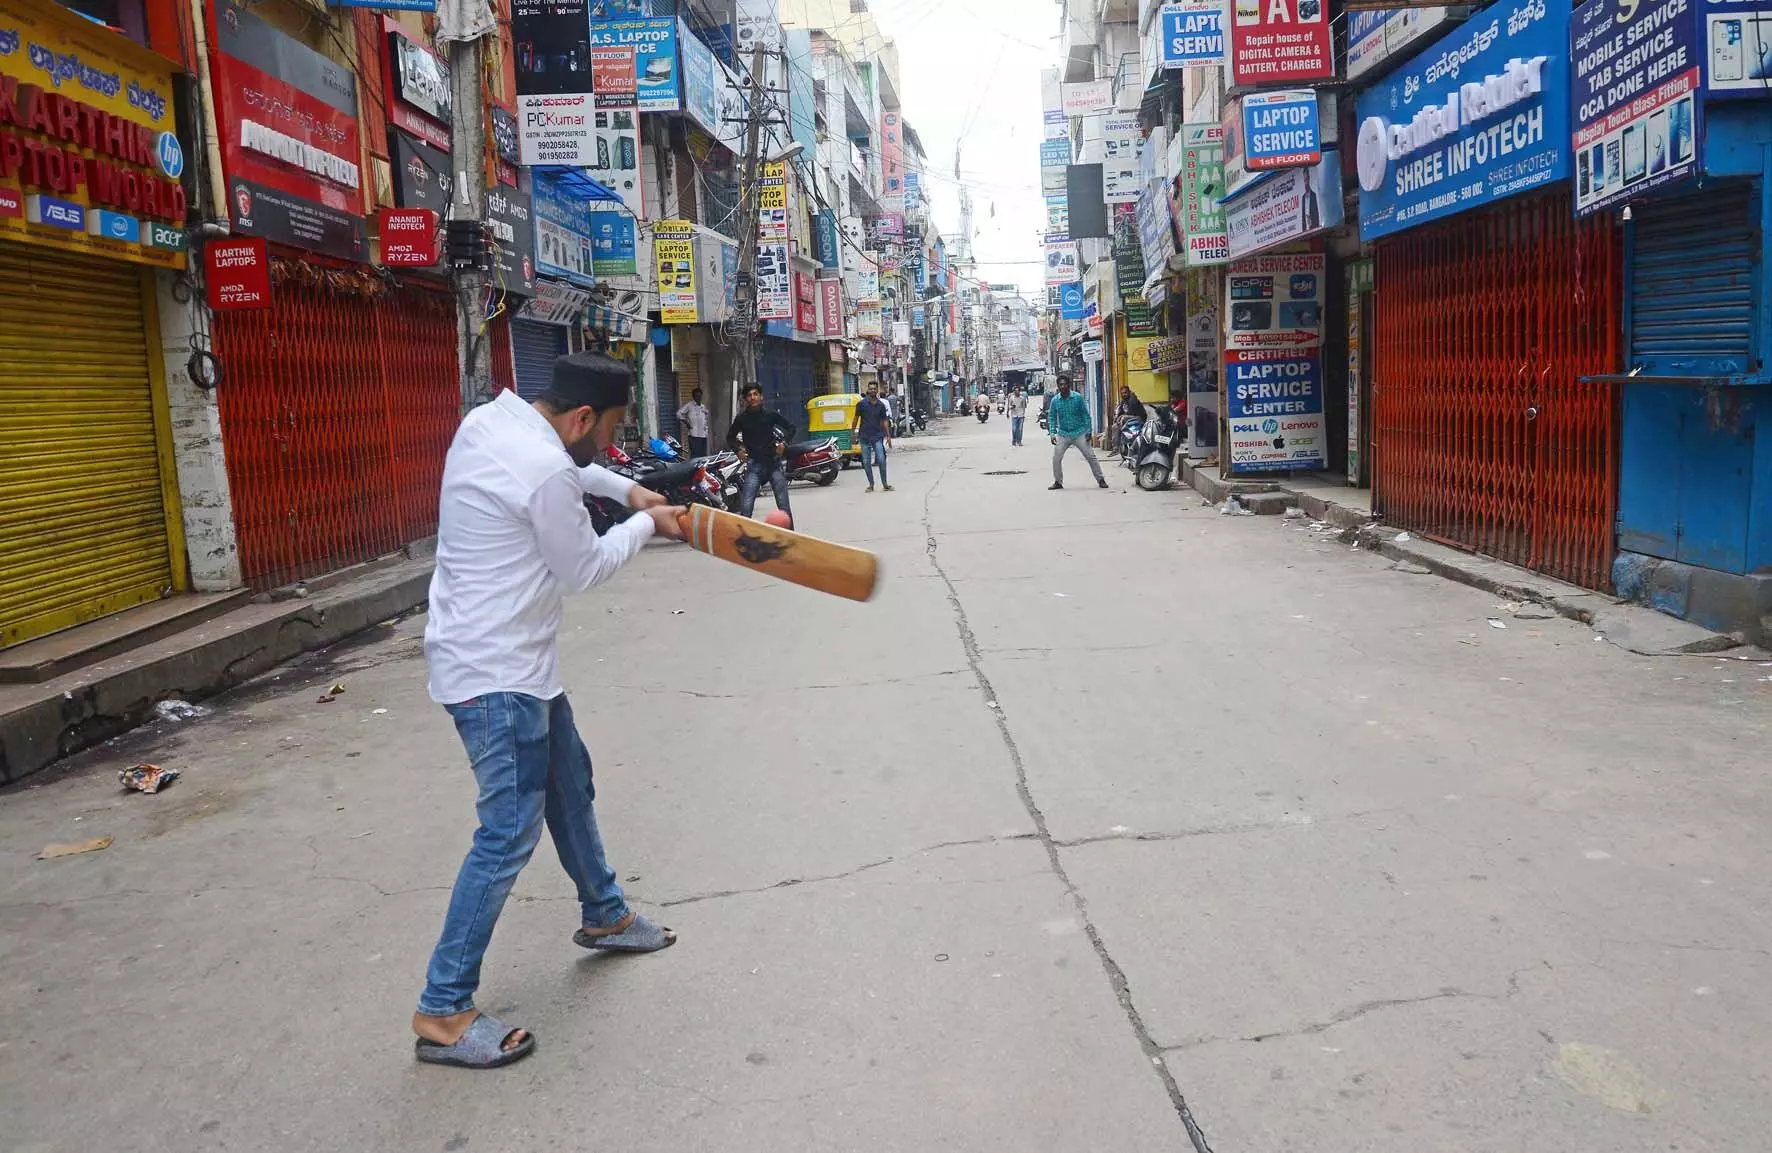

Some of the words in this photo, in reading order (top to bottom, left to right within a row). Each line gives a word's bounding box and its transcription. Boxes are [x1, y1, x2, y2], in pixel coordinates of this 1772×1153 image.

[618, 31, 669, 42] LAPTOP
[1246, 34, 1274, 47] Repair
[1276, 33, 1302, 43] house
[1304, 31, 1313, 42] of
[1577, 33, 1623, 77] MOBILE
[1627, 0, 1687, 46] SERVICE
[1240, 48, 1272, 60] DIGITAL
[1274, 45, 1311, 58] CAMERA
[1314, 44, 1320, 55] &
[1588, 66, 1612, 93] TAB
[1615, 27, 1674, 77] SERVICE
[1240, 62, 1279, 75] BATTERY,
[1281, 59, 1322, 71] CHARGER
[1580, 95, 1605, 122] OCA
[1607, 70, 1644, 107] DONE
[1648, 45, 1687, 84] HERE
[527, 112, 585, 127] PCKumar
[1253, 106, 1310, 128] LAPTOP
[1578, 121, 1605, 144] Display
[1607, 108, 1631, 129] Touch
[1632, 94, 1656, 116] Glass
[1658, 77, 1689, 102] Fitting
[0, 72, 157, 168] KARTHIK
[1253, 129, 1314, 153] SERVICE
[1396, 149, 1443, 196] SHREE
[1448, 104, 1543, 177] INFOTECH
[1276, 153, 1310, 163] FLOOR
[1488, 164, 1513, 185] SHREE
[1514, 150, 1559, 177] INFOTECH
[88, 158, 187, 223] WORLD
[1187, 150, 1199, 232] ABHISHEK
[47, 204, 81, 224] ASUS
[1274, 194, 1300, 217] TELECOM
[239, 217, 253, 228] msi
[388, 223, 425, 231] INFOTECH
[155, 227, 183, 247] acer
[820, 216, 832, 262] EPSON
[215, 247, 255, 258] KARTHIK
[388, 253, 428, 262] RYZEN
[216, 257, 257, 268] LAPTOPS
[1260, 256, 1292, 273] SERVICE
[1293, 255, 1324, 272] CENTER
[1231, 279, 1272, 287] GoPro
[220, 292, 260, 302] RYZEN
[827, 286, 839, 331] Lenovo
[1238, 350, 1307, 361] CERTIFIED
[1237, 362, 1311, 380] LAPTOP
[1236, 380, 1313, 400] SERVICE
[1242, 401, 1306, 415] CENTER
[1233, 424, 1259, 432] DELL
[1281, 420, 1319, 431] Lenovo
[1233, 440, 1269, 448] TOSHIBA
